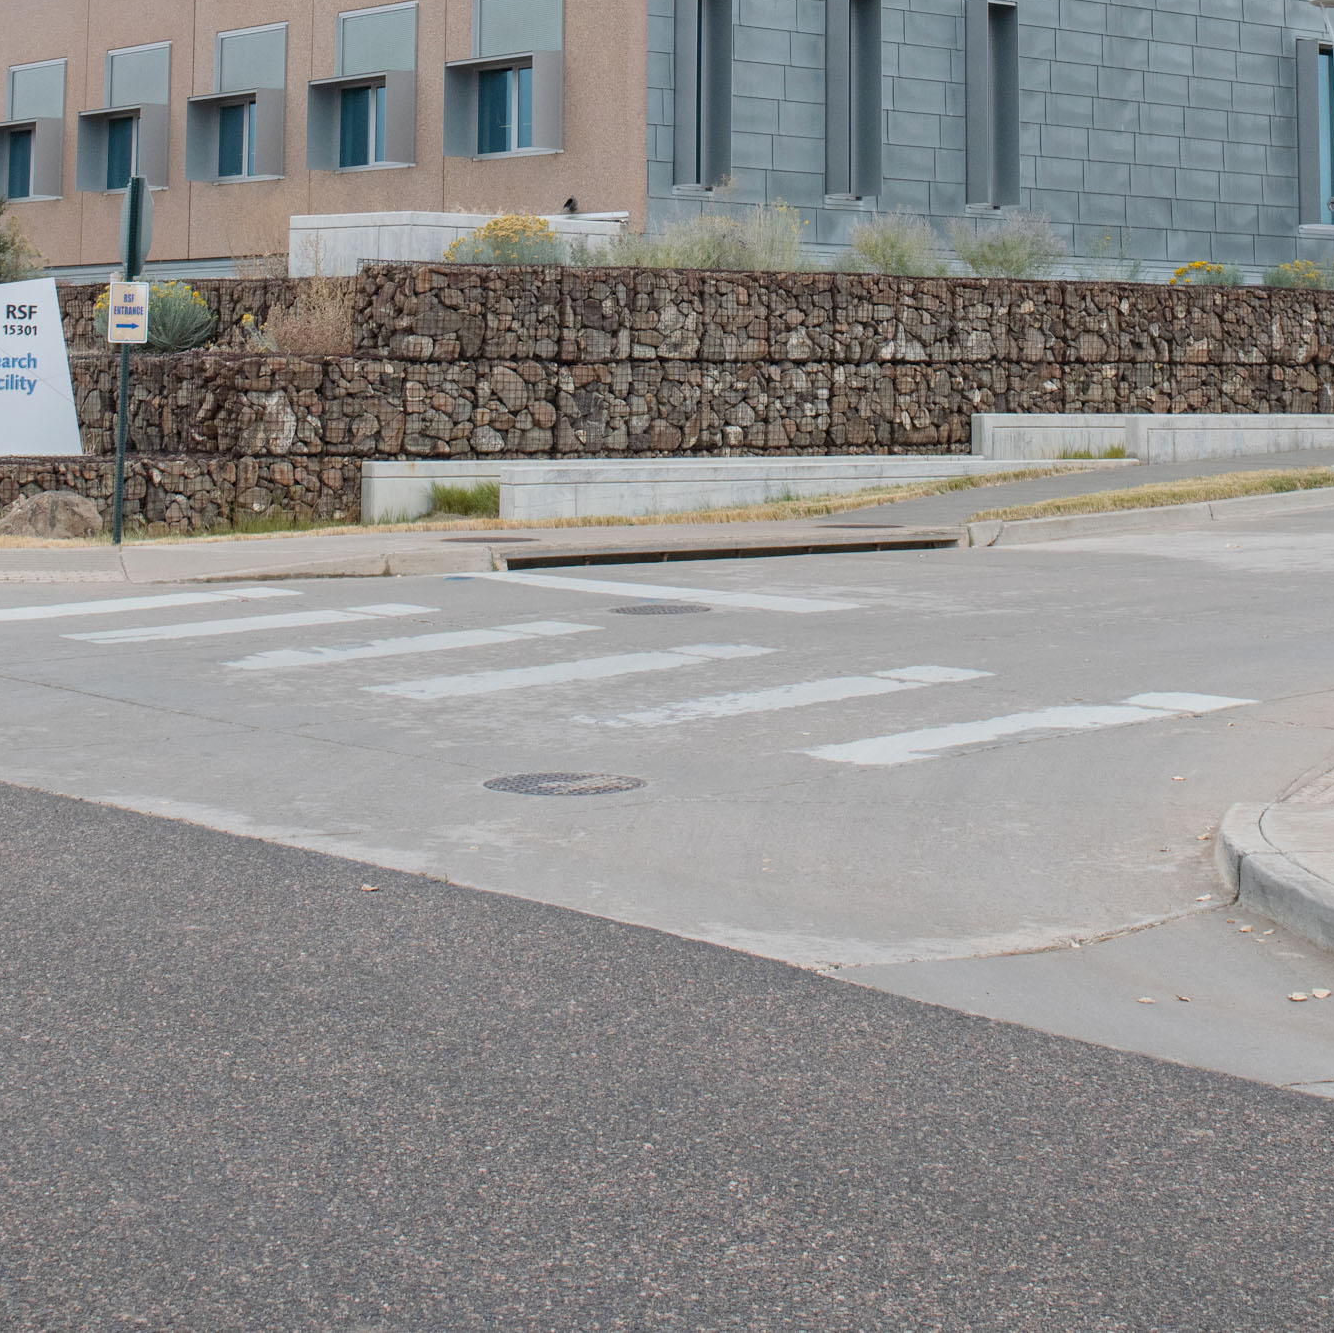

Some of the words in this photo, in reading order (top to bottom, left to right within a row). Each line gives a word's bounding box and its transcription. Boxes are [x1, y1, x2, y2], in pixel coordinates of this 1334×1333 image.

[123, 293, 134, 303] RSF
[5, 304, 38, 320] RSF
[113, 306, 144, 315] ENTRANCE
[2, 324, 38, 336] 15301
